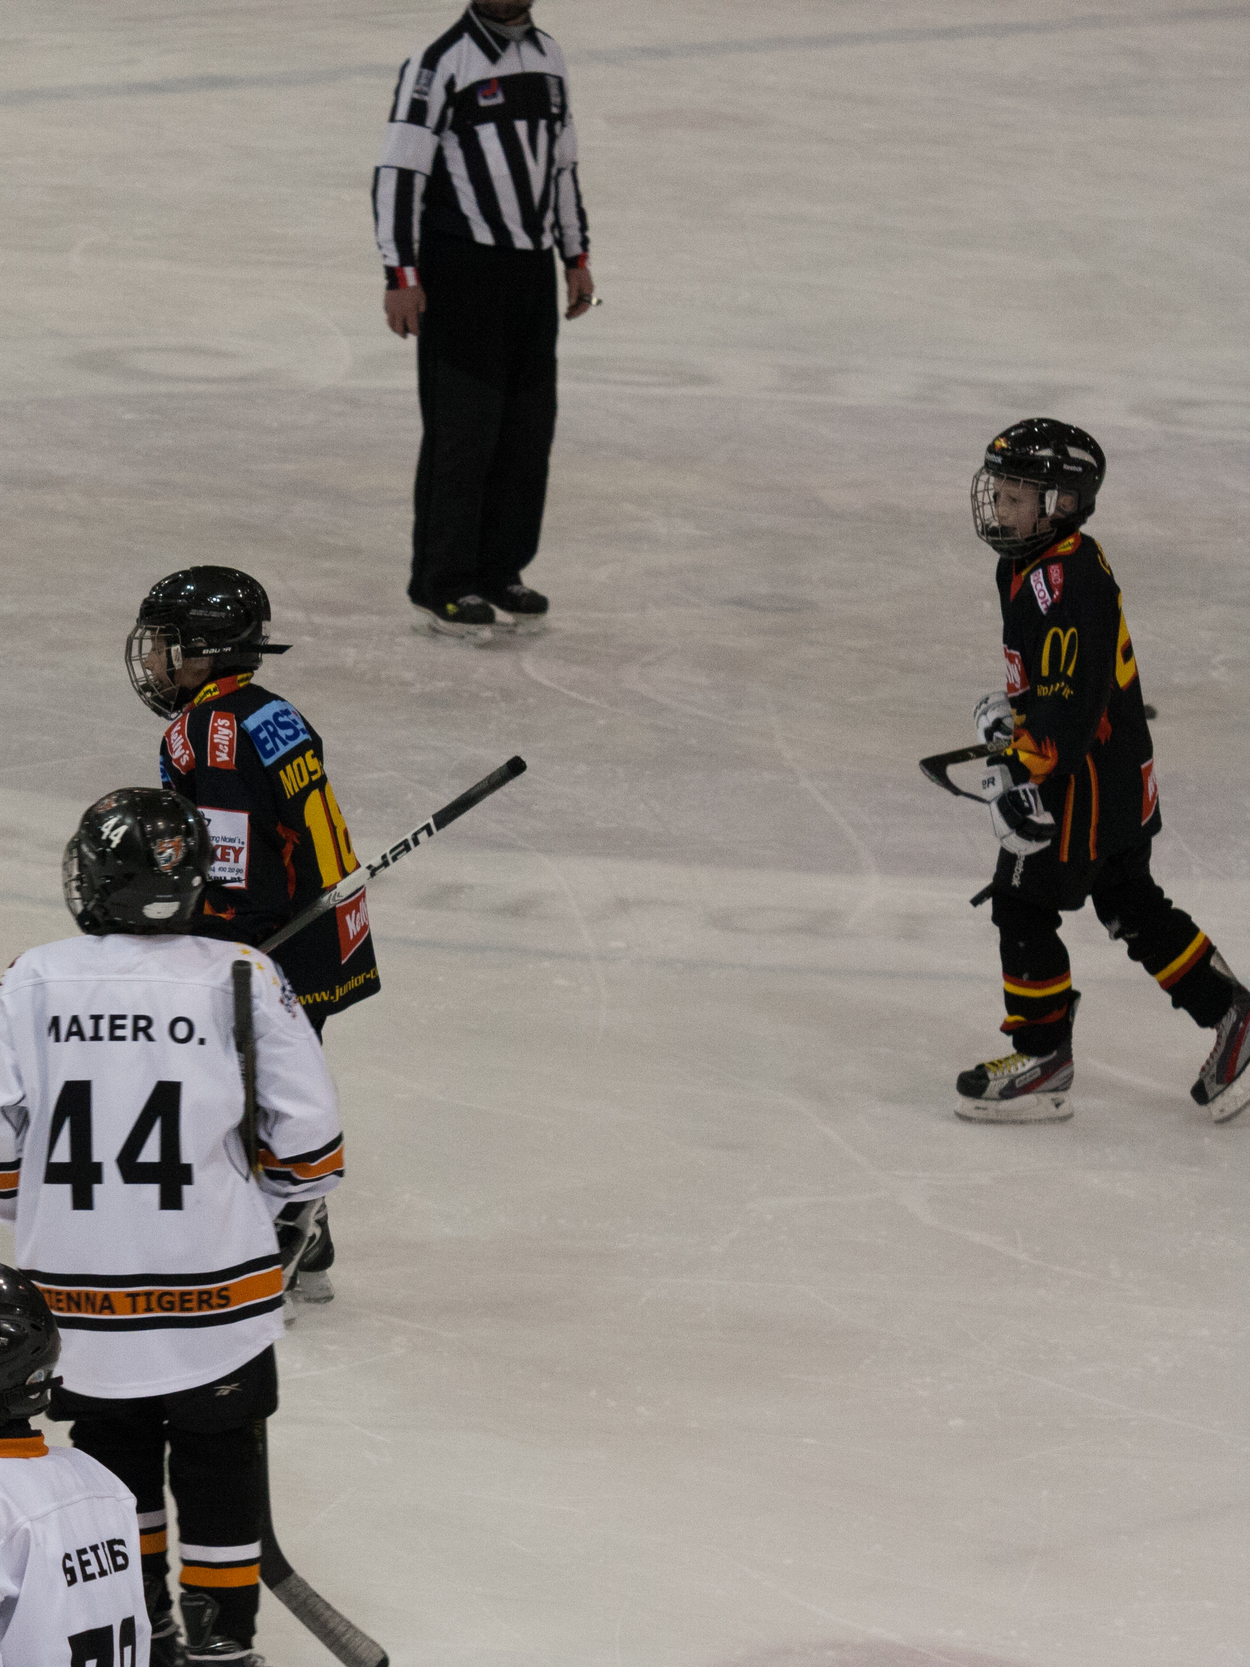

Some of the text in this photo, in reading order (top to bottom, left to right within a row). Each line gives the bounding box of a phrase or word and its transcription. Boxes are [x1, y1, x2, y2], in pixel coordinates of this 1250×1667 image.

[279, 748, 325, 800] MOS
[101, 814, 129, 849] 44
[48, 1014, 206, 1046] MAIER O.
[43, 1080, 193, 1211] 44
[126, 1286, 232, 1314] TIGERS
